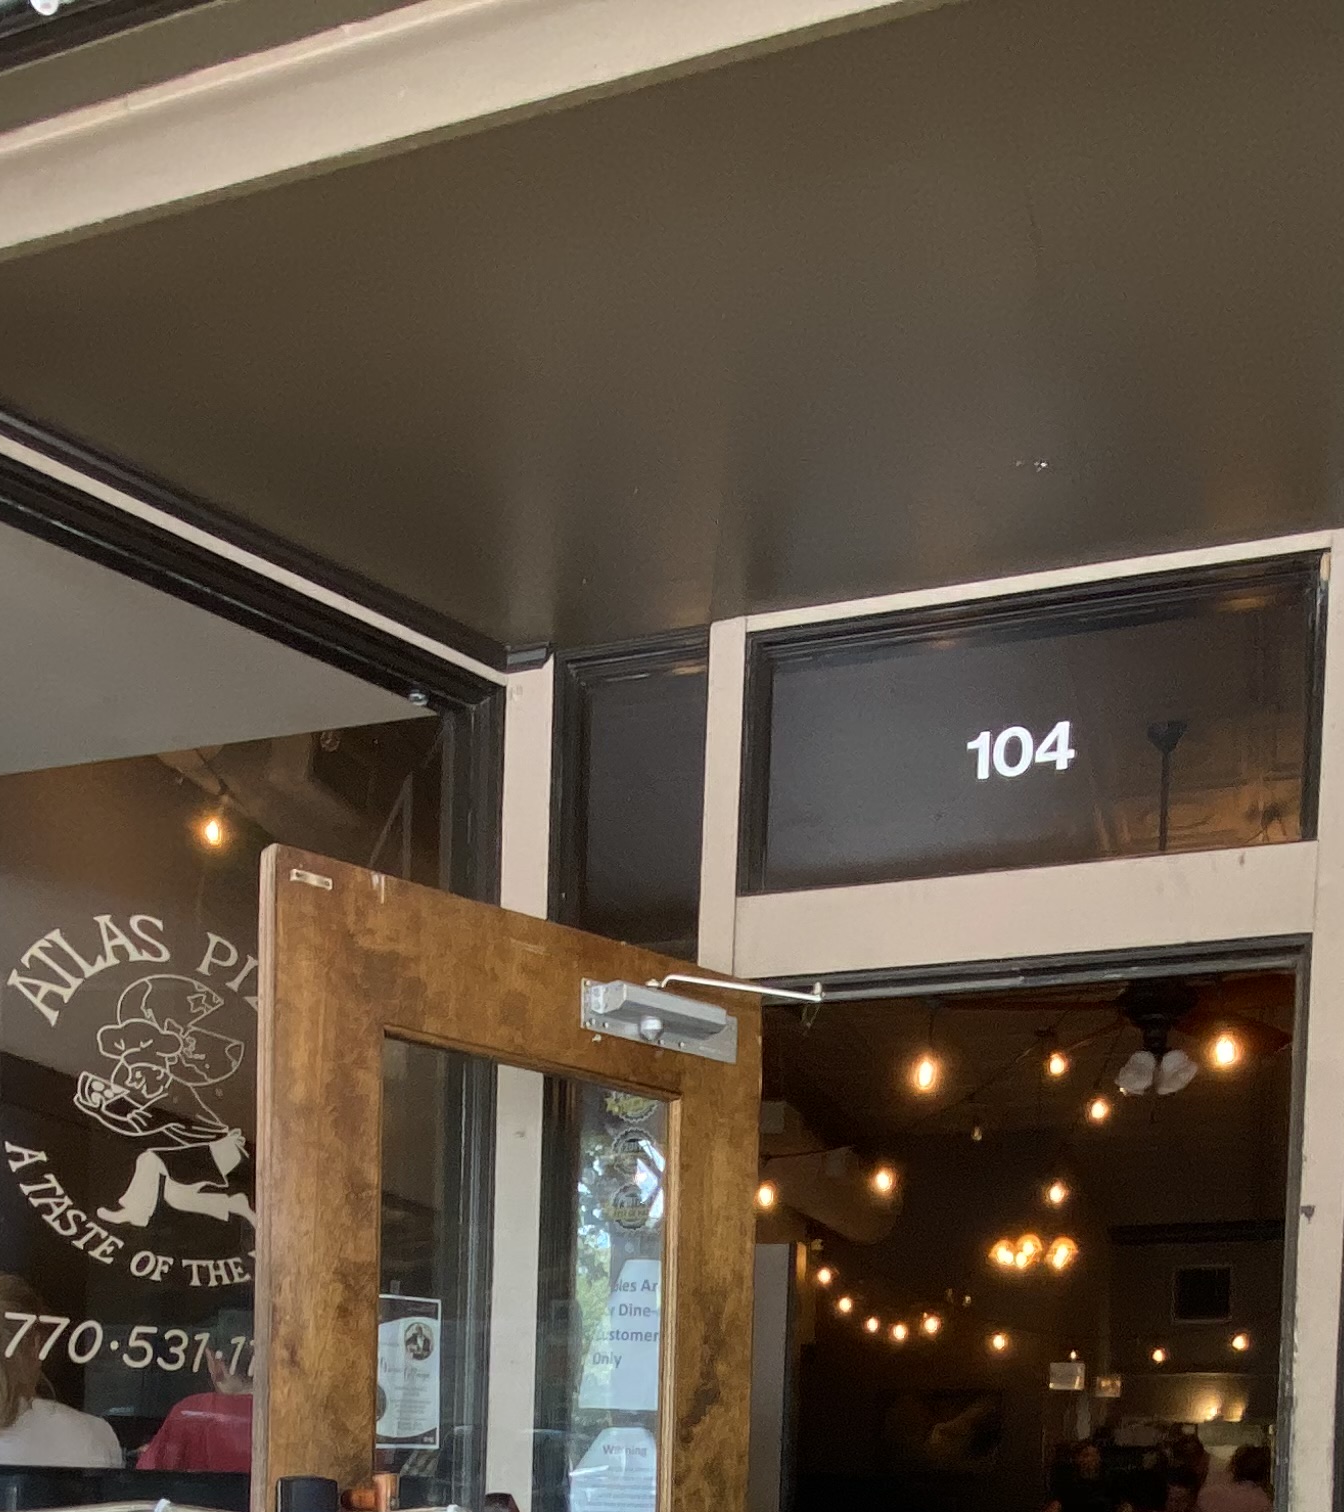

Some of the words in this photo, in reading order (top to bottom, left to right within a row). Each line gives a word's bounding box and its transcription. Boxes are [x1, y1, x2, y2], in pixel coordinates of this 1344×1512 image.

[967, 720, 1077, 780] 104
[7, 914, 171, 1027] ATLAS
[5, 1140, 48, 1173] A
[19, 1173, 124, 1264] TASTE
[130, 1251, 174, 1282] OF
[182, 1257, 251, 1287] THE
[592, 1351, 622, 1368] Only
